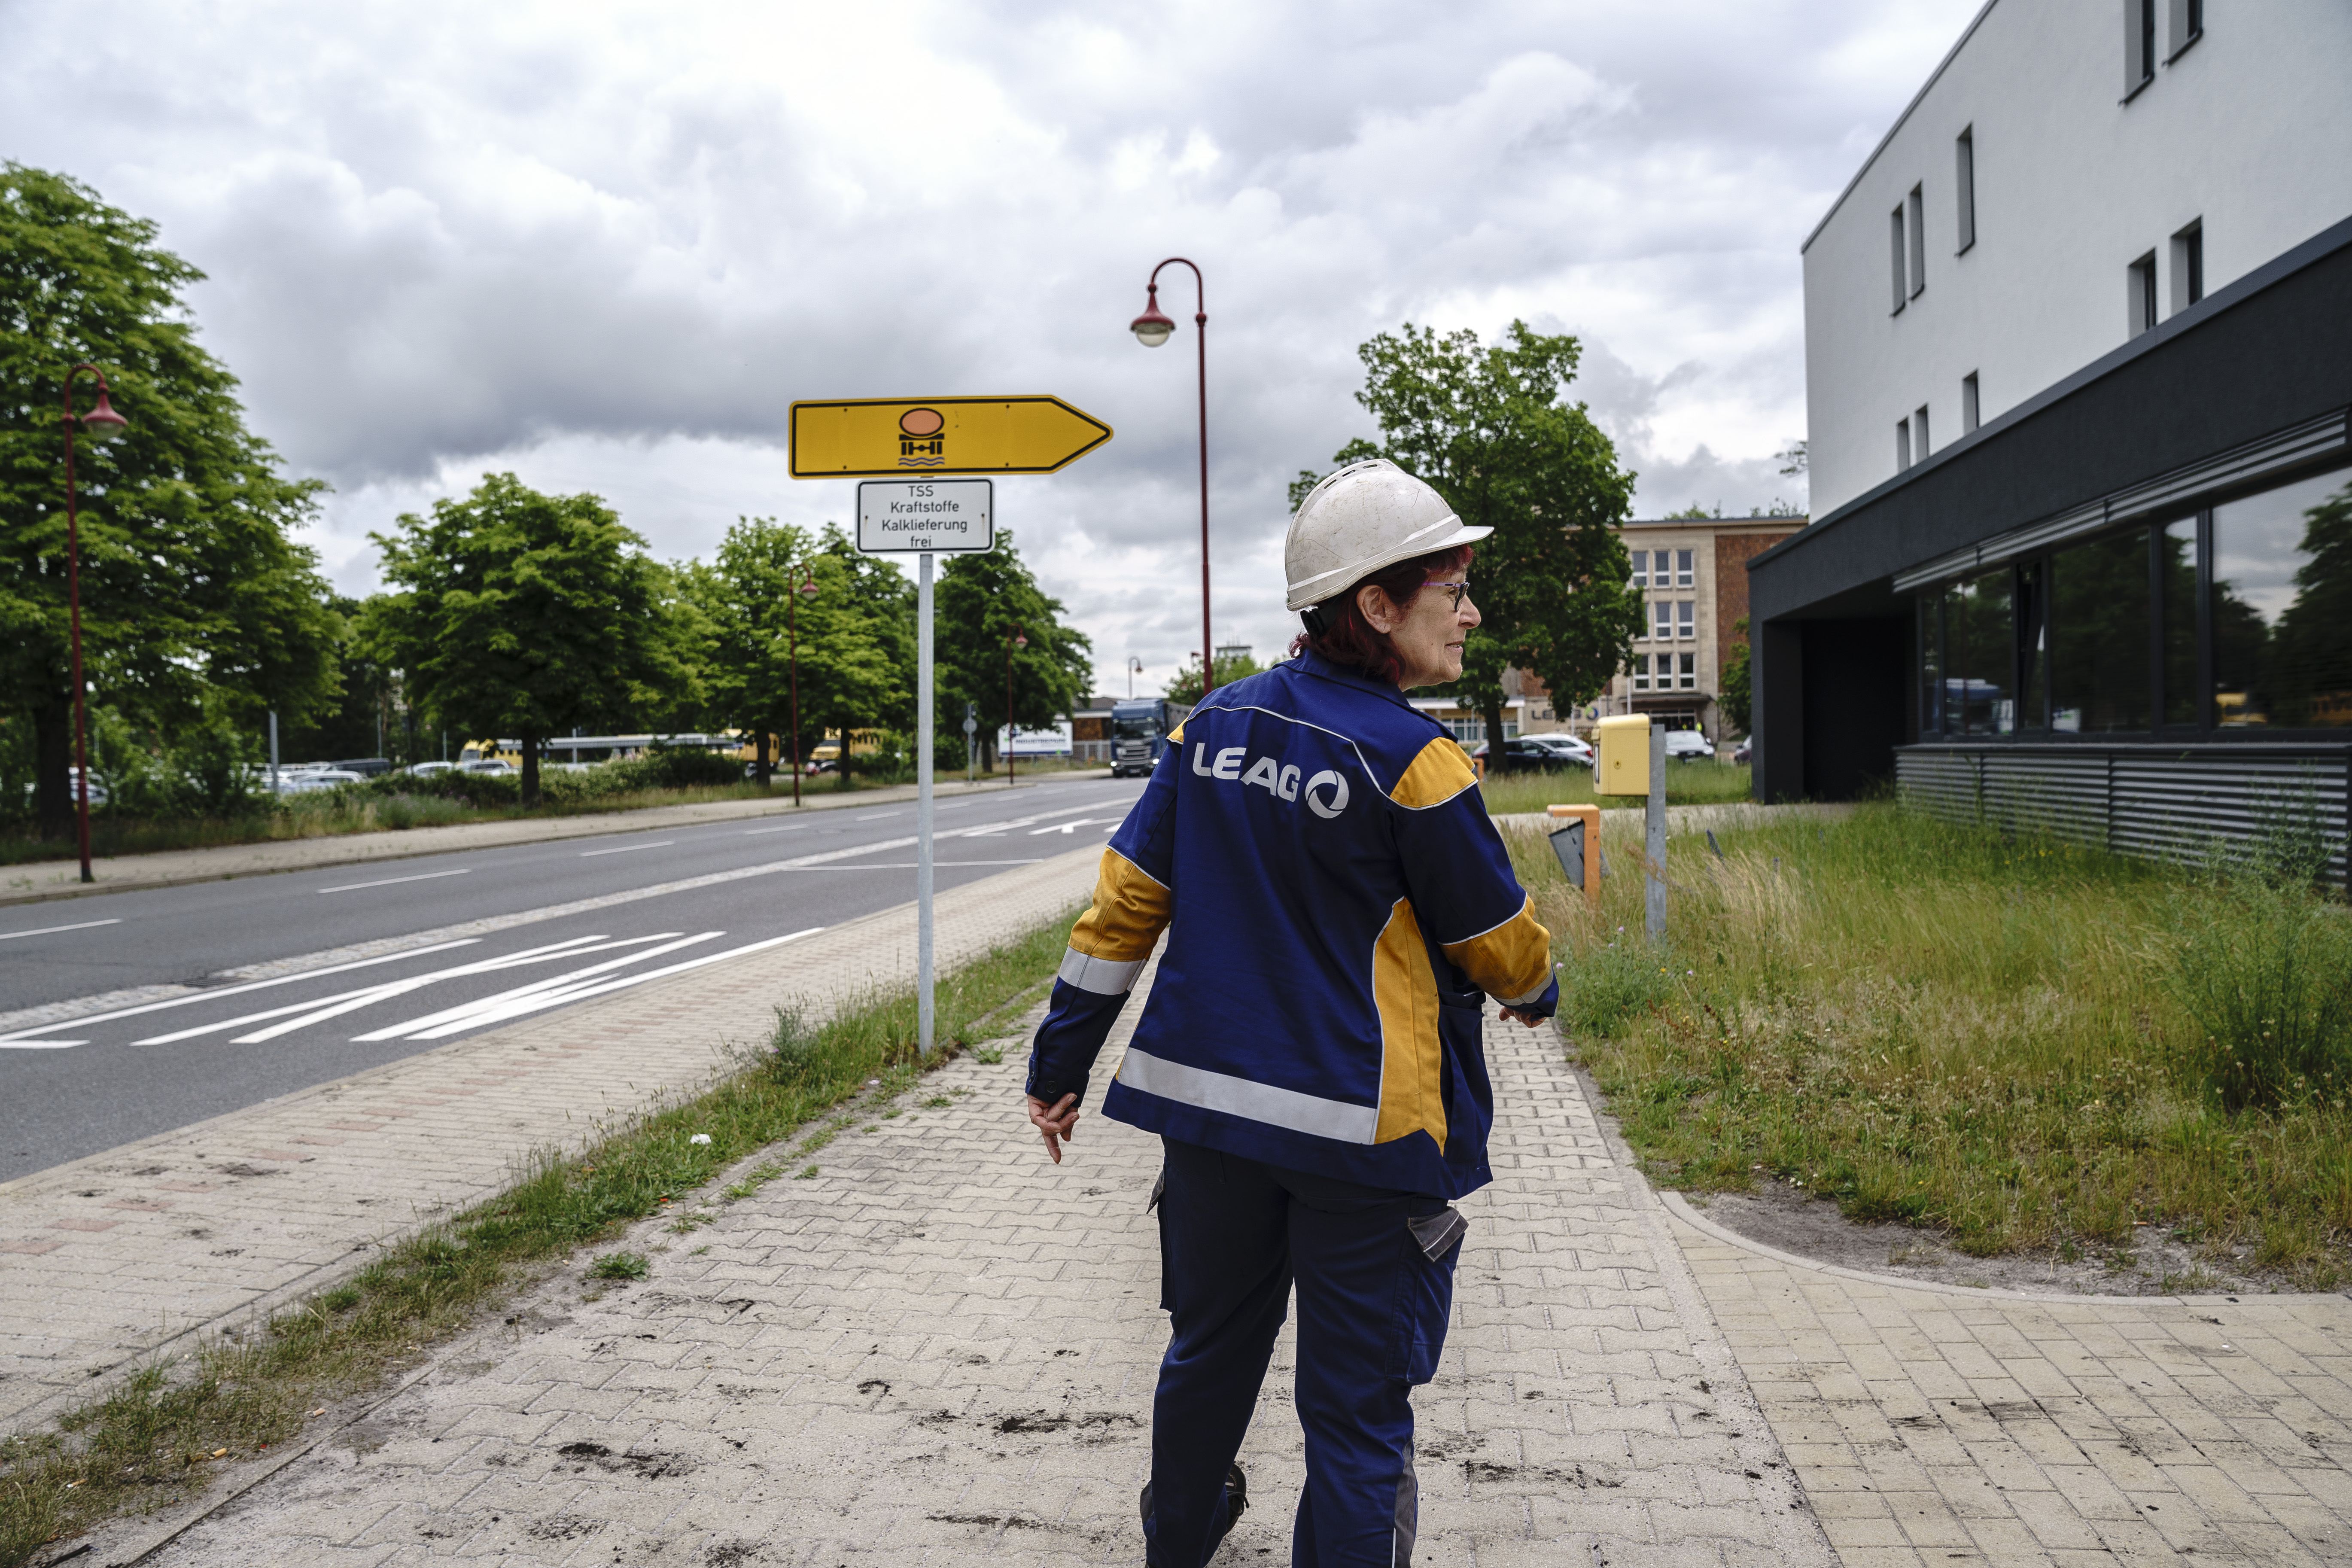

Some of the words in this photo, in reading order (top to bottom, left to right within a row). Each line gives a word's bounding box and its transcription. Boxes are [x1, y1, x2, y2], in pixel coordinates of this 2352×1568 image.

[908, 485, 934, 497] TSS
[891, 500, 959, 513] Kraftstoffe
[882, 519, 968, 533] Kalklieferung
[910, 535, 931, 548] frei
